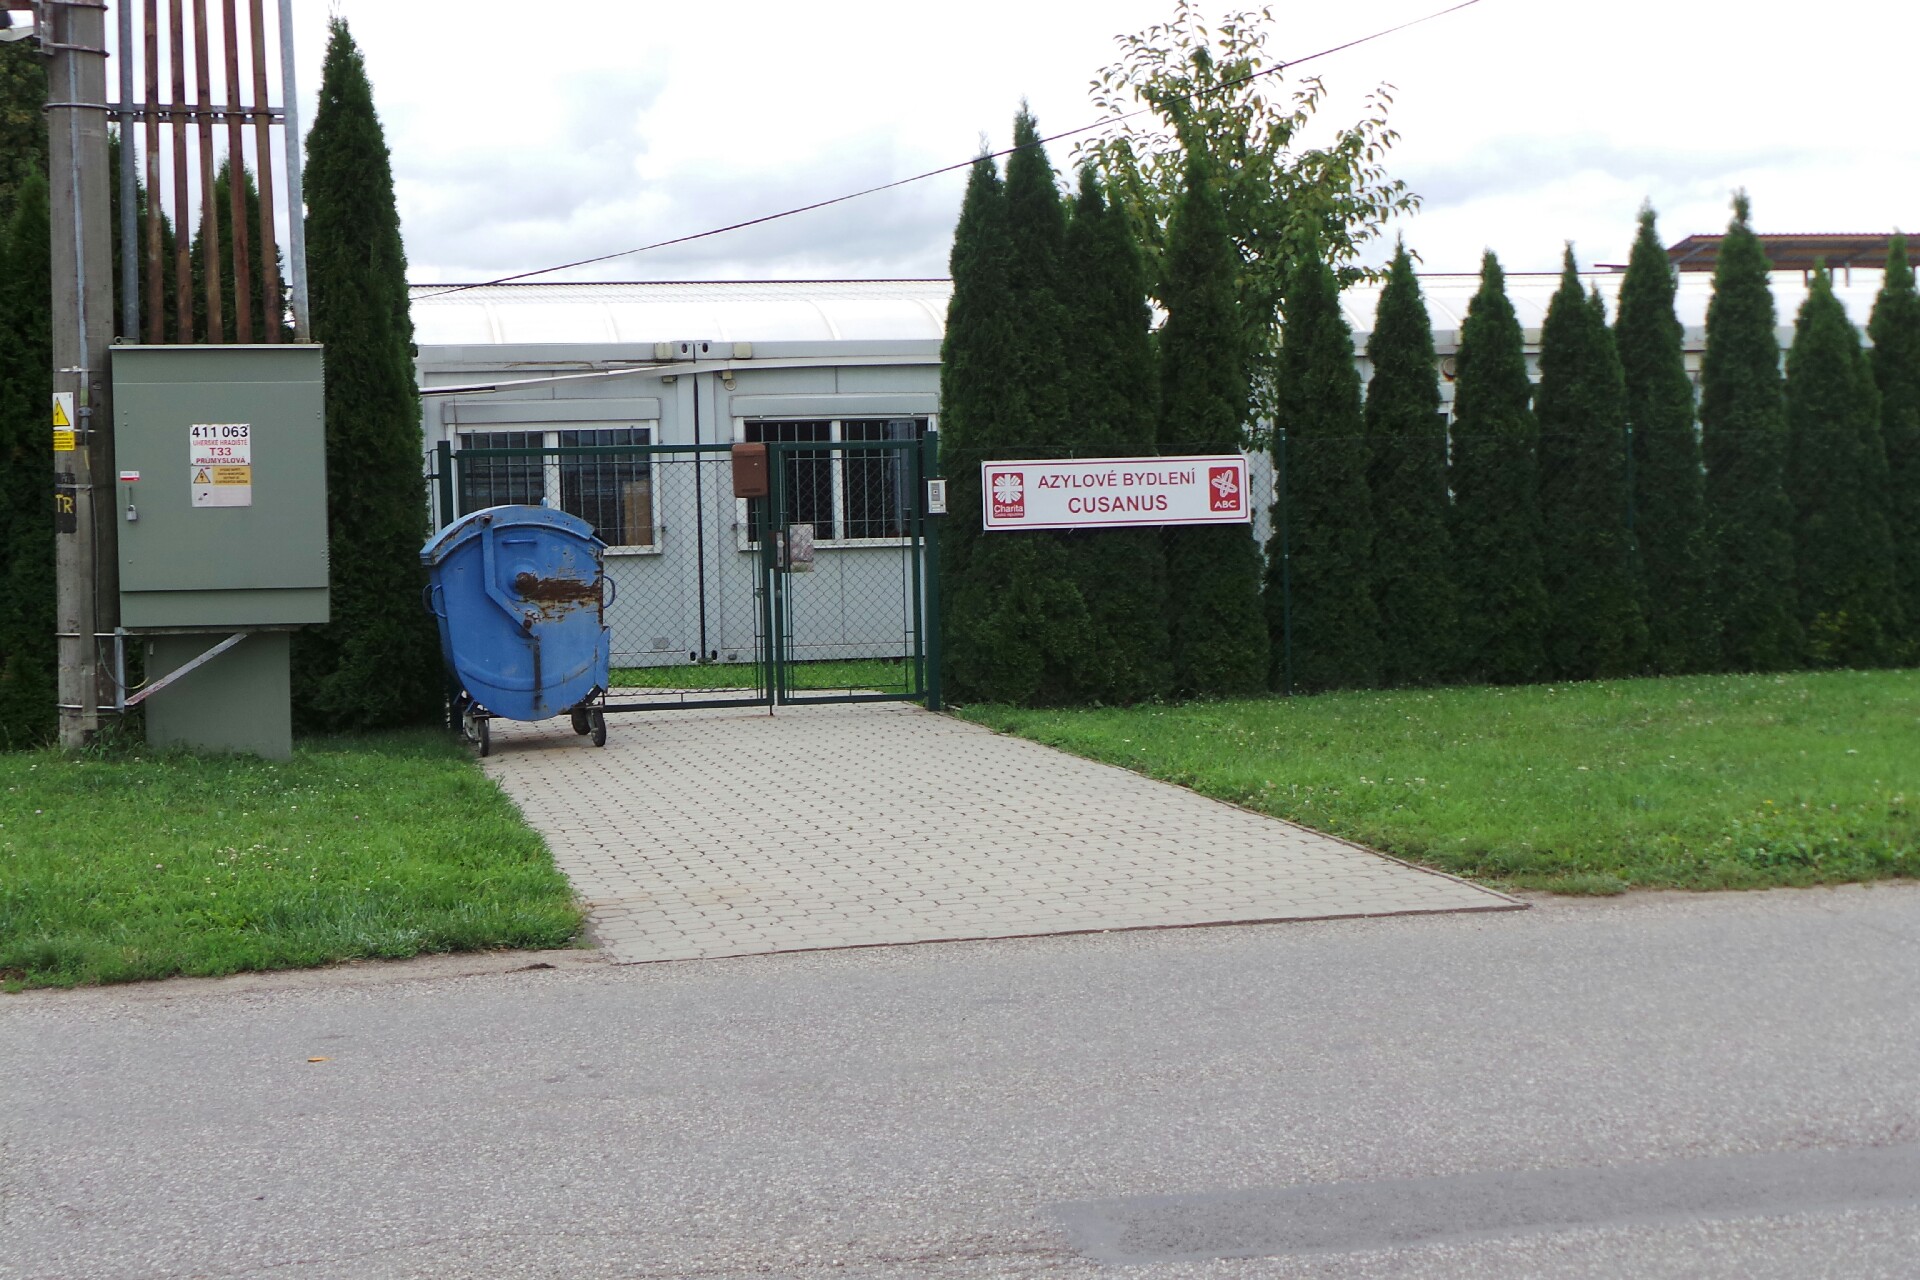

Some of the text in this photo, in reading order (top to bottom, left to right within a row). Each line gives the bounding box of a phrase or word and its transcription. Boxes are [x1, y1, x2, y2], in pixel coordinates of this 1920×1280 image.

[192, 426, 248, 438] 411 063
[209, 447, 232, 456] T33
[1038, 467, 1196, 489] AZYLOVÉ BYDLENÍ
[55, 494, 73, 514] TR
[994, 504, 1024, 513] Charita
[1068, 494, 1168, 514] CUSANUS
[1214, 500, 1237, 509] ABC
